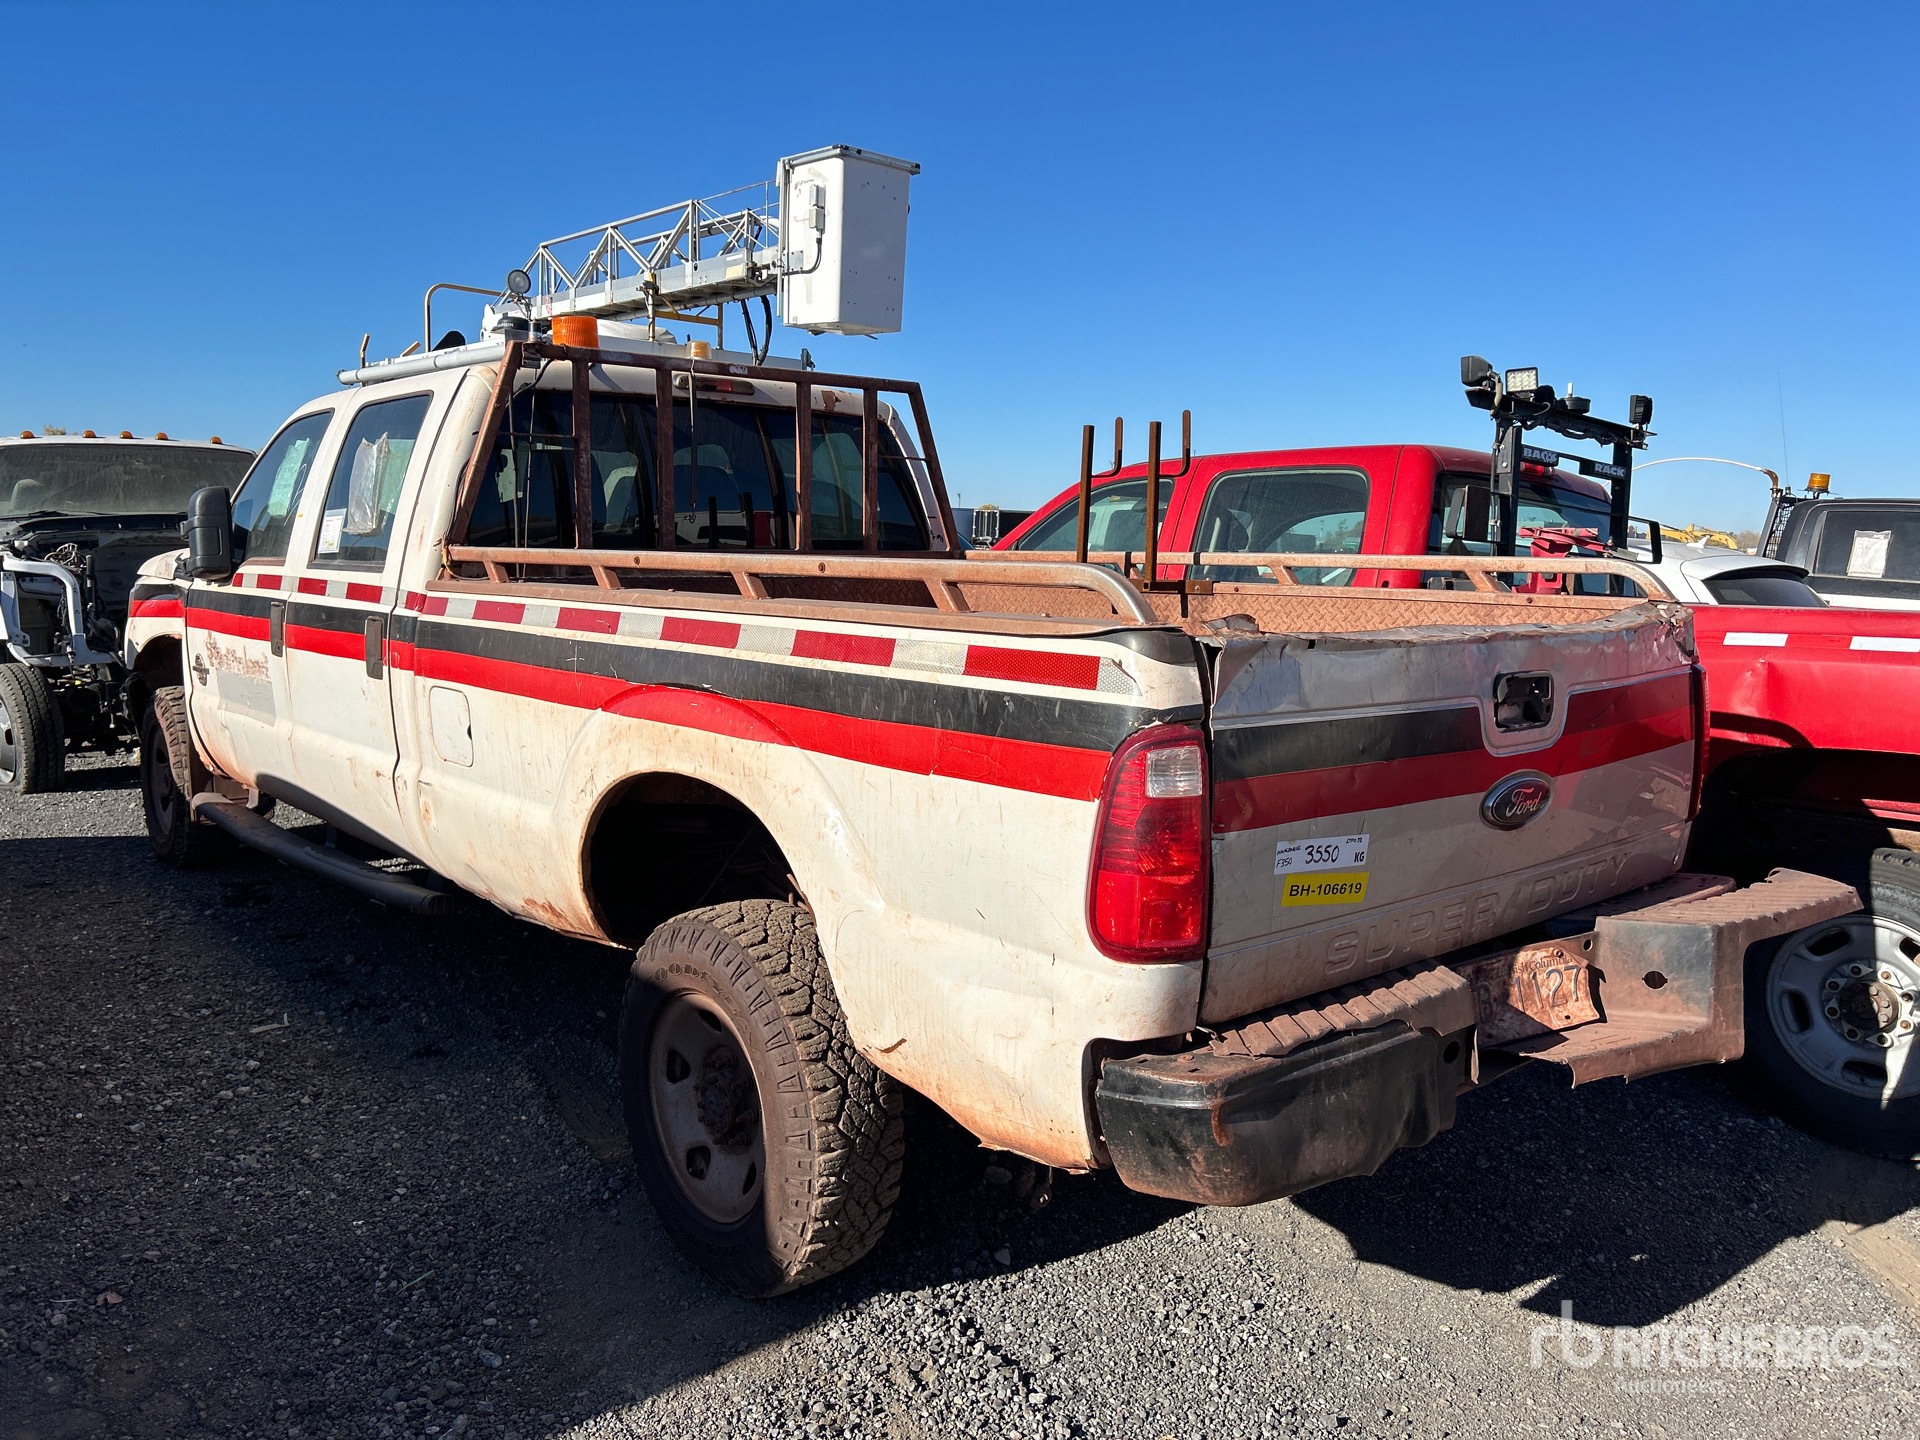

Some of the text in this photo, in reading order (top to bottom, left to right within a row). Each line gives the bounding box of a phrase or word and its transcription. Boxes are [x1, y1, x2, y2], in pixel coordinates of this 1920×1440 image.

[1594, 463, 1625, 477] RACK
[1505, 787, 1542, 817] Ford
[1276, 857, 1293, 869] F350
[1304, 845, 1340, 865] 3550
[1354, 851, 1365, 863] KG
[1289, 882, 1362, 897] BH-106619
[1323, 852, 1632, 976] SUPER DUTY
